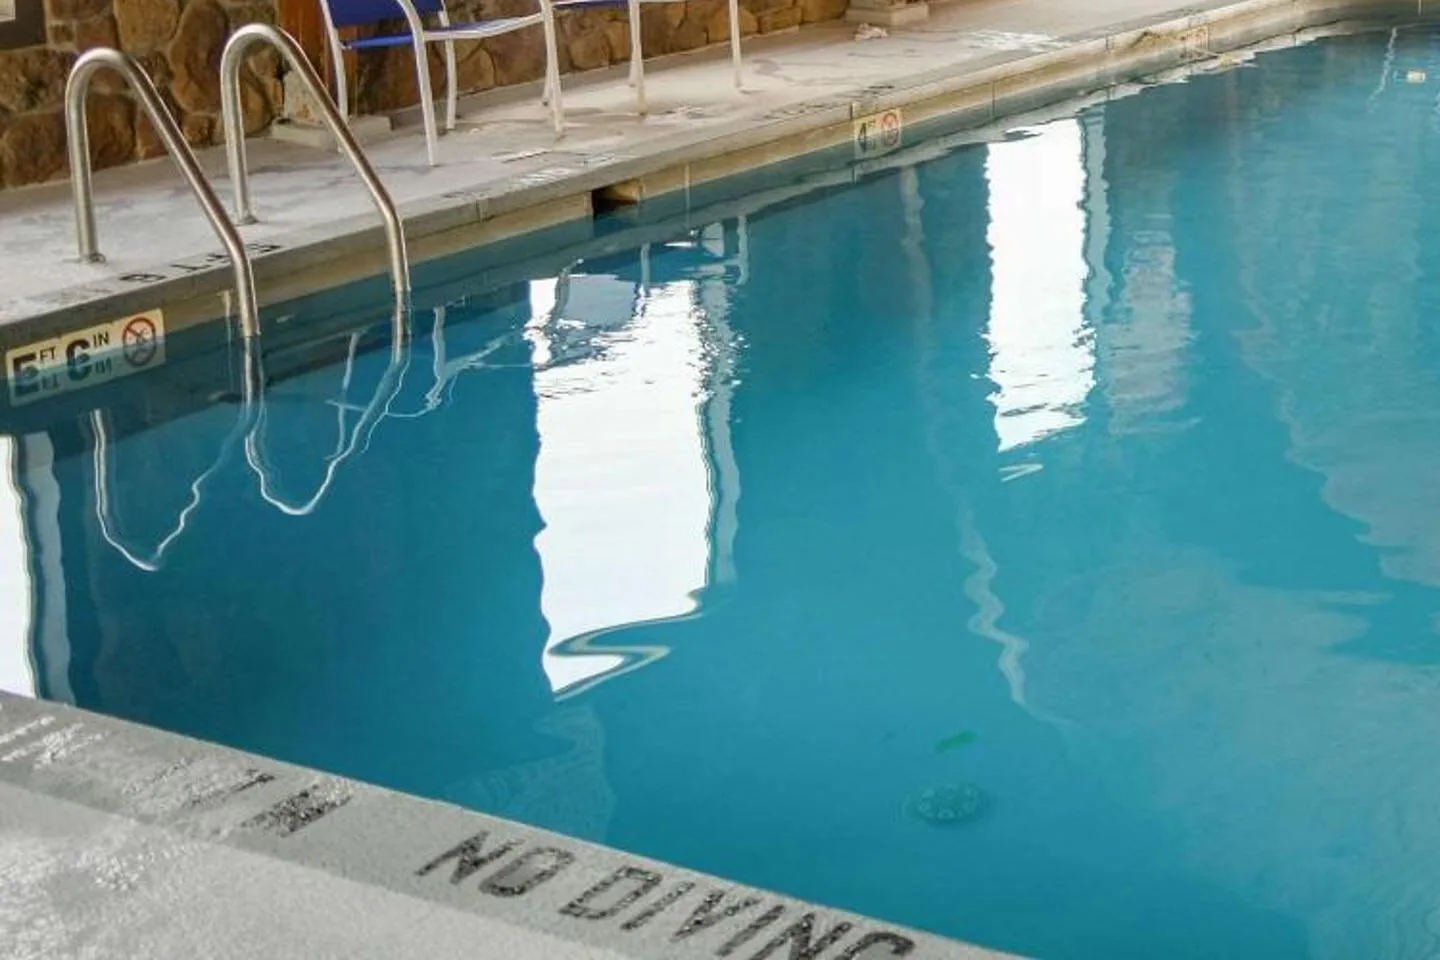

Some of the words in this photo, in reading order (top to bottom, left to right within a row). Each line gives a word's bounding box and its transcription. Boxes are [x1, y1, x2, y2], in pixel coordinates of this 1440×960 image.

[40, 346, 57, 361] FT
[93, 330, 110, 349] IN
[413, 830, 574, 898] NO
